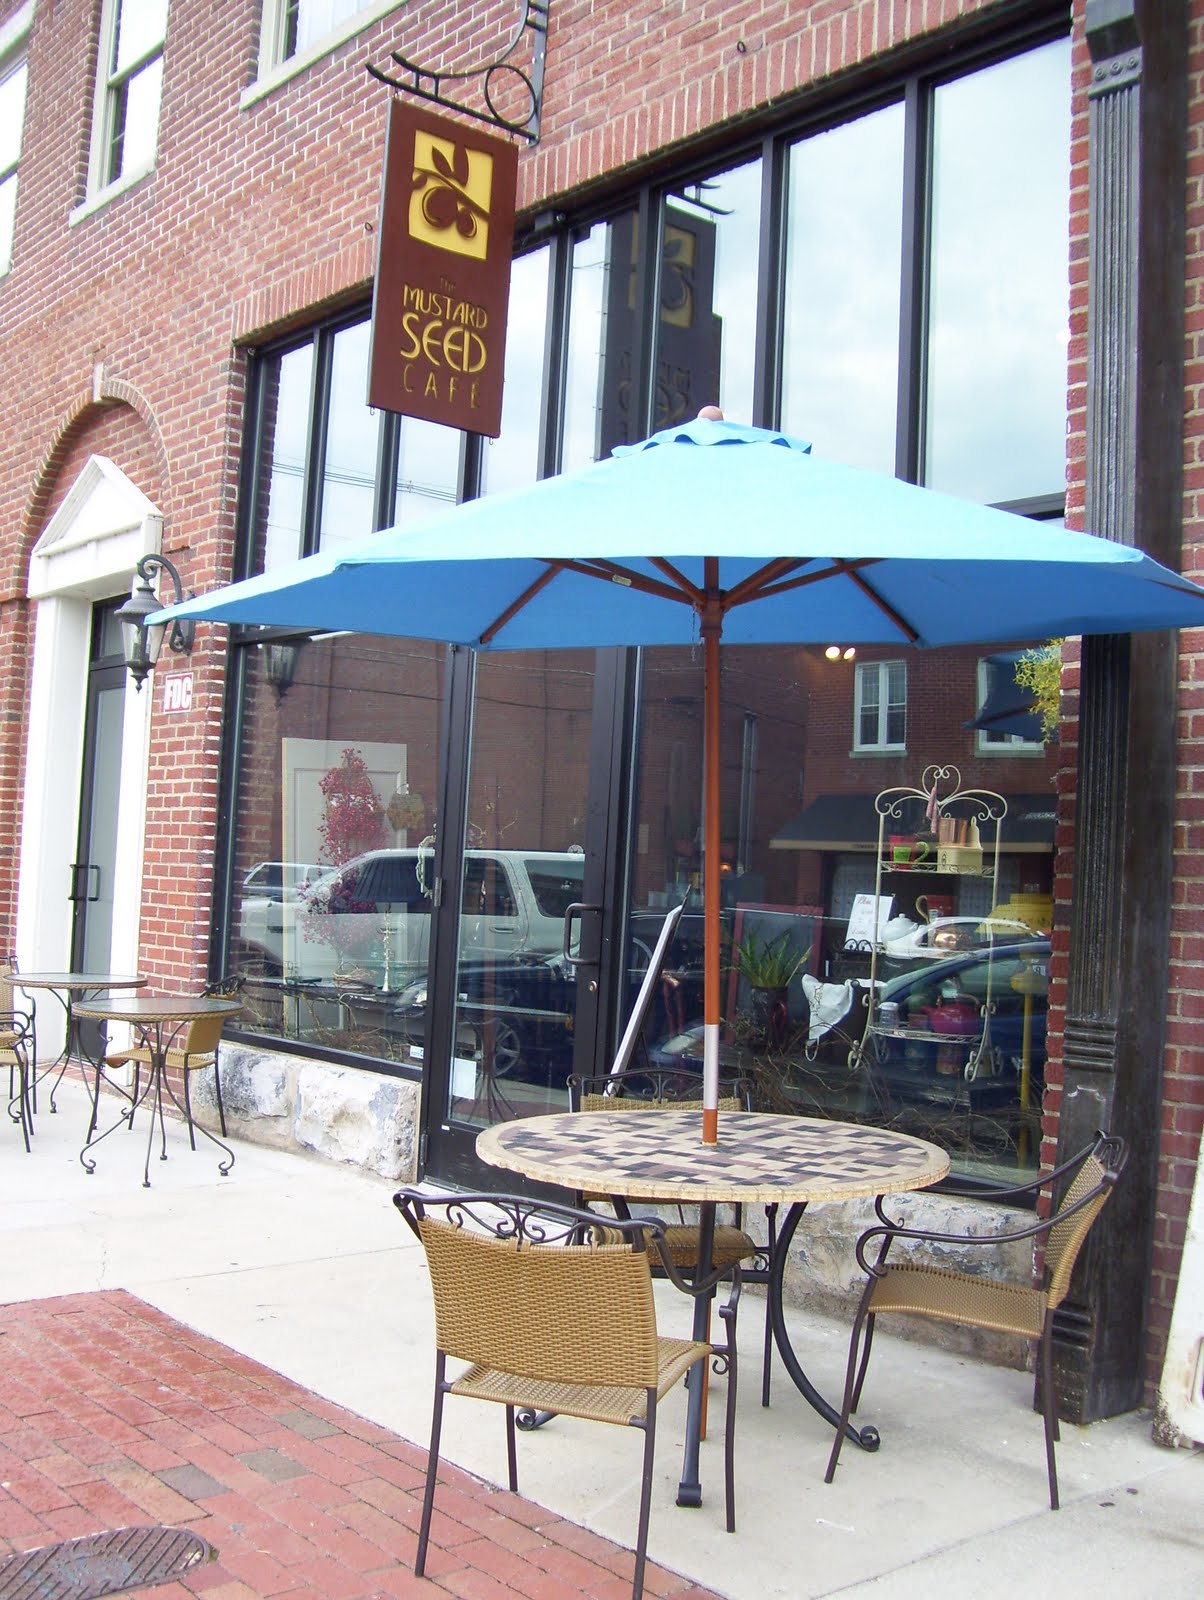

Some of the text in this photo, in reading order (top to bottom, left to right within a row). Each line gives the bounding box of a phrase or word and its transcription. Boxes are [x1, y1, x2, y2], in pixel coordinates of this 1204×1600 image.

[403, 284, 488, 328] MUSTARD
[400, 311, 487, 373] SEED
[164, 676, 192, 710] FDC
